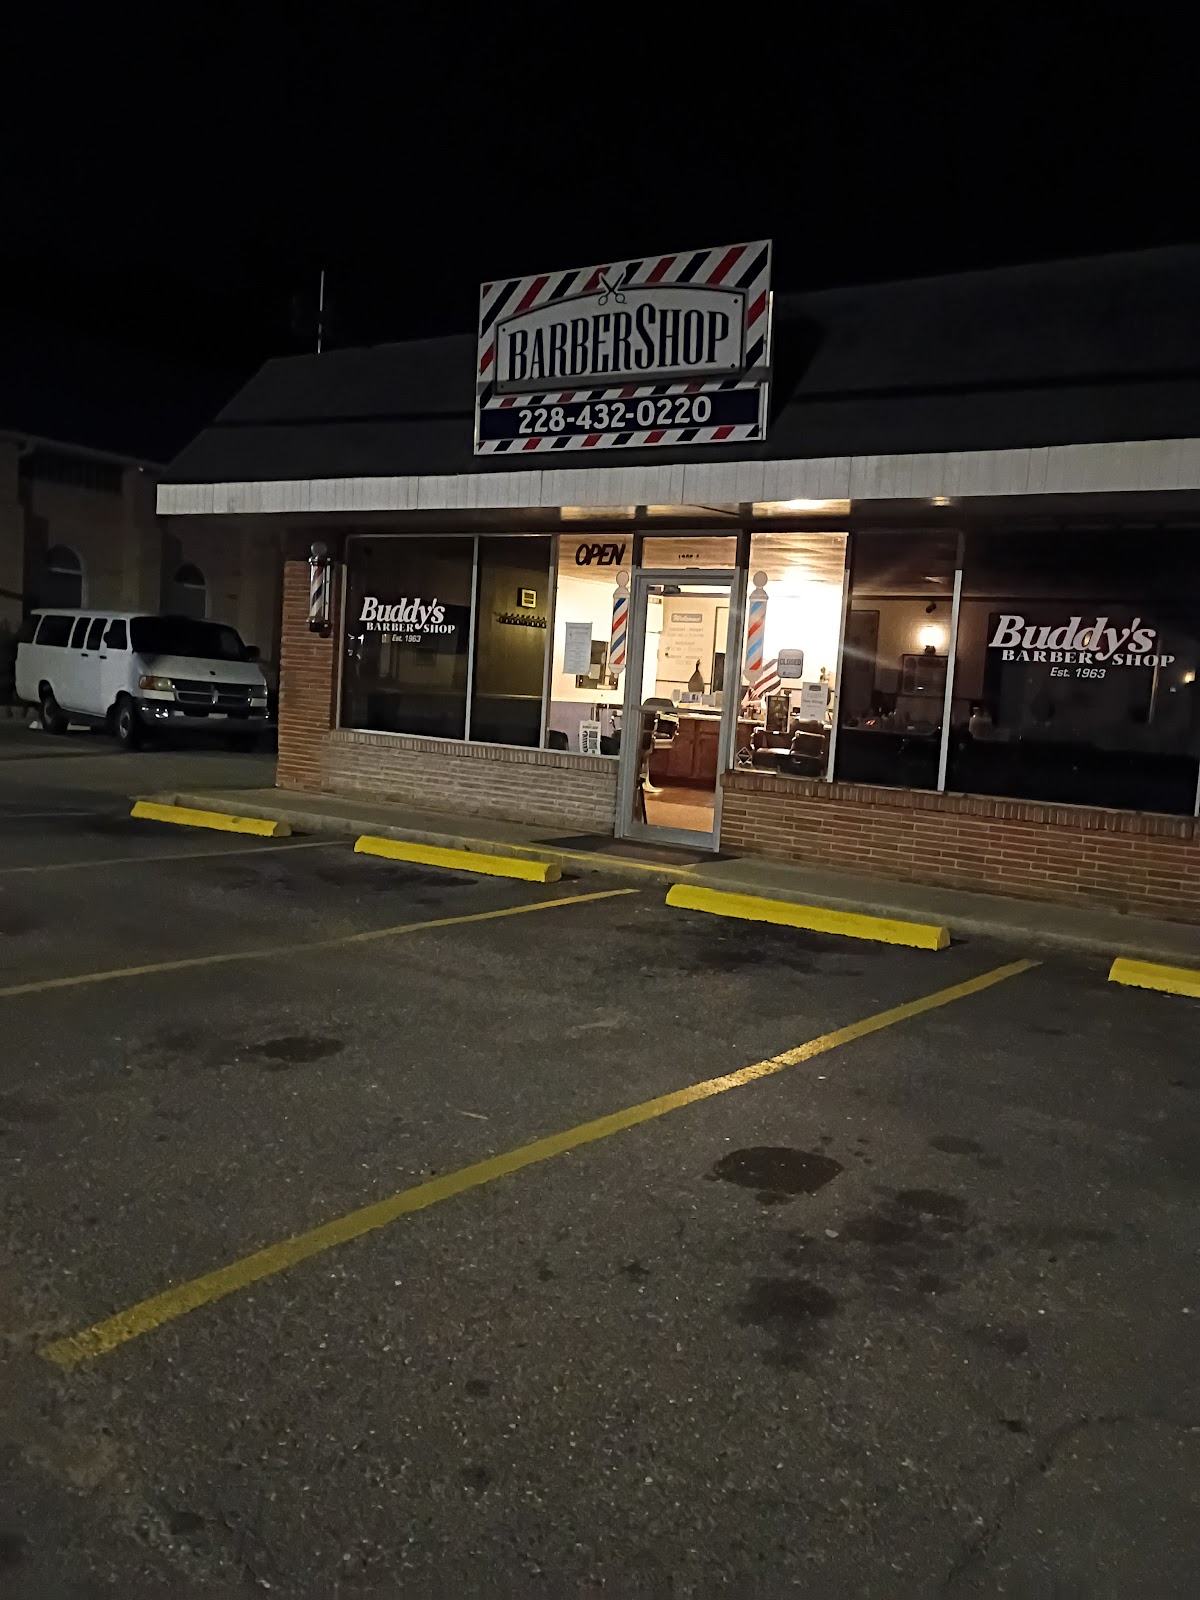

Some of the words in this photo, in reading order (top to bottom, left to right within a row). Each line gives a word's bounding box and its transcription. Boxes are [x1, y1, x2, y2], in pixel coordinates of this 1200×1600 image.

[507, 303, 729, 381] BARBERSHOP
[518, 396, 712, 434] 228-432-0220
[575, 543, 626, 566] OPEN
[359, 597, 446, 630] Buddy's
[367, 622, 414, 632] BARBER
[423, 624, 456, 634] SHOP
[988, 615, 1157, 661] Buddy's
[1002, 649, 1094, 664] BARBER
[1111, 653, 1175, 668] SHOP
[1050, 667, 1070, 677] Est.
[1075, 668, 1106, 679] 1963
